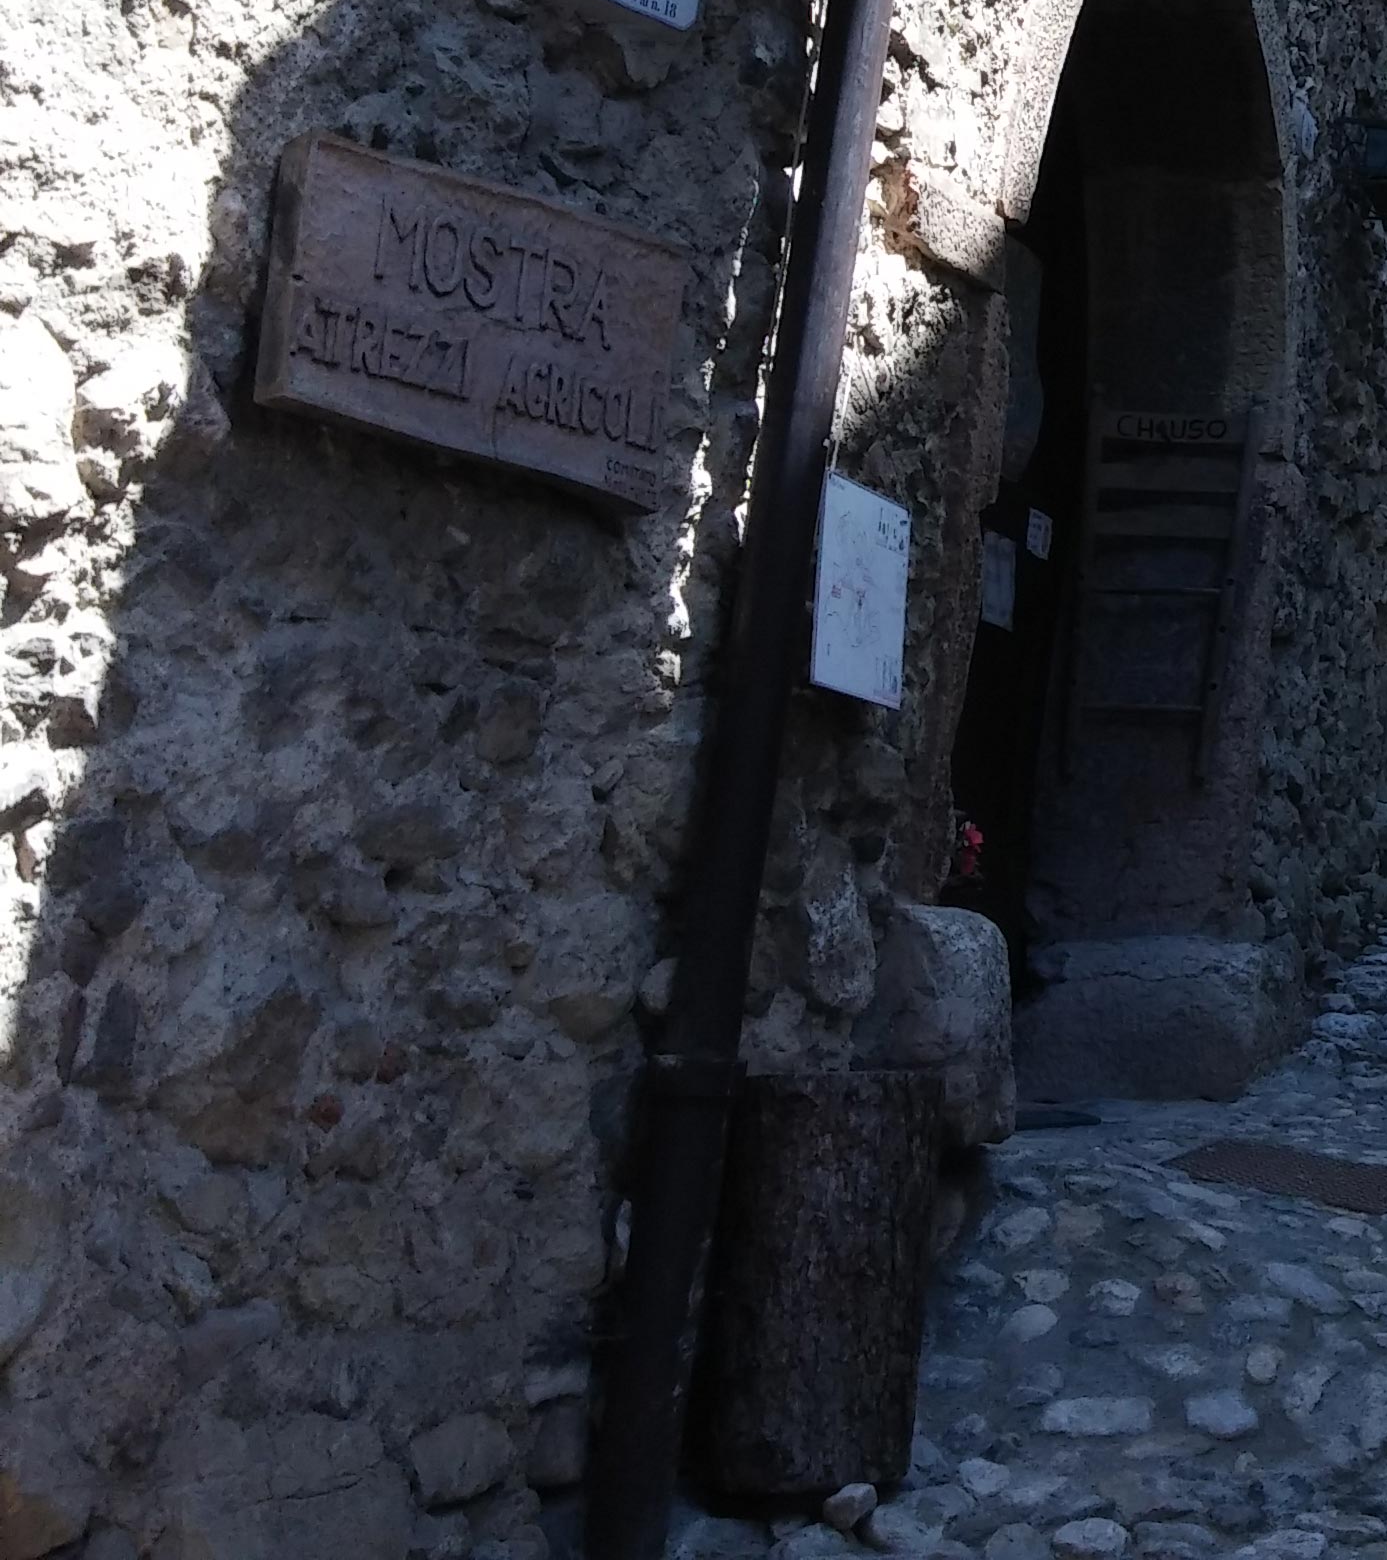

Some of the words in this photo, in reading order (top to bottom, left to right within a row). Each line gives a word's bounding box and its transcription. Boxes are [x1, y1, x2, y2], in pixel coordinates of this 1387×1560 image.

[651, 0, 660, 12] n.
[664, 0, 677, 18] 18
[373, 195, 611, 351] MOSTRA
[495, 354, 664, 454] AGRICOLI
